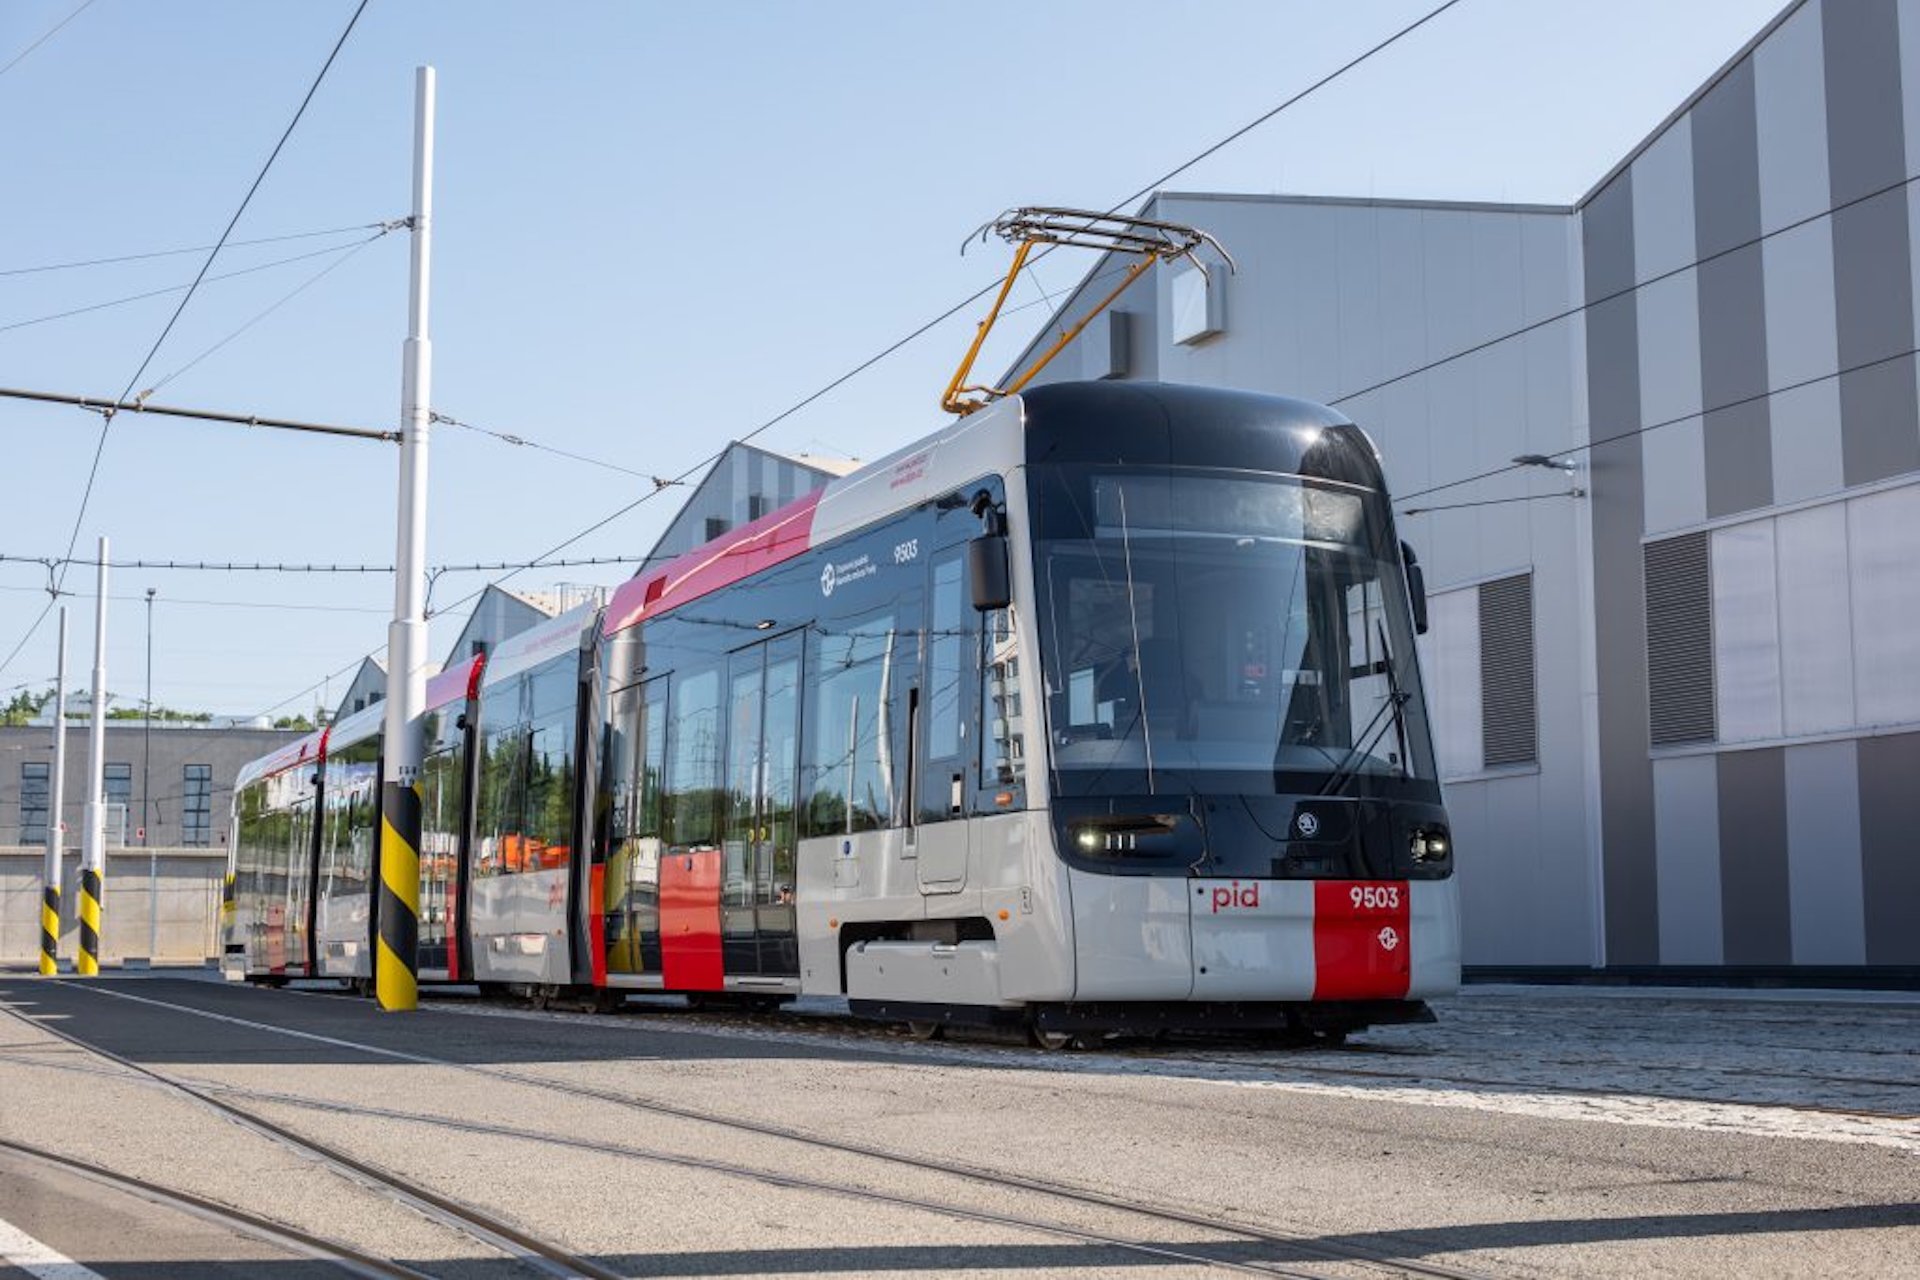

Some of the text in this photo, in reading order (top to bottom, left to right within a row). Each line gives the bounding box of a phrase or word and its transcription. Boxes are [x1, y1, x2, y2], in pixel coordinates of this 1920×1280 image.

[894, 538, 918, 564] 9503
[1212, 880, 1259, 914] pid
[1350, 886, 1399, 909] 9503
